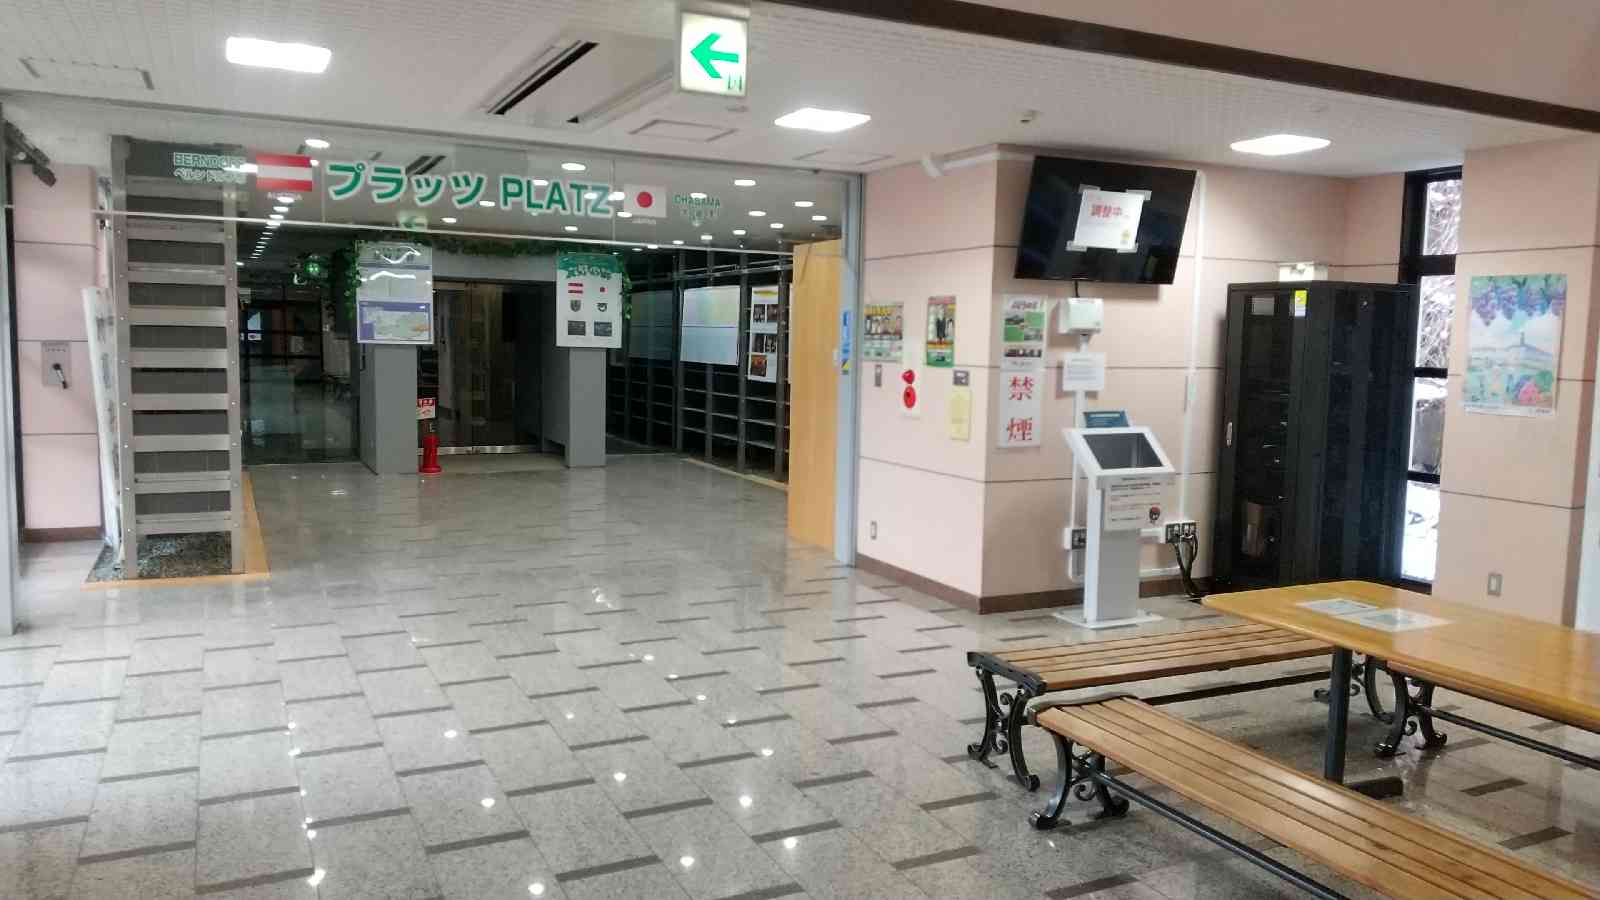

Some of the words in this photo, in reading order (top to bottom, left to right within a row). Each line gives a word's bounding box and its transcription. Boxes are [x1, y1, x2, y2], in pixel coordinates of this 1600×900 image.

[327, 161, 486, 206] プラッツ
[500, 174, 612, 217] PLATZ
[1007, 375, 1034, 441] 禁煙
